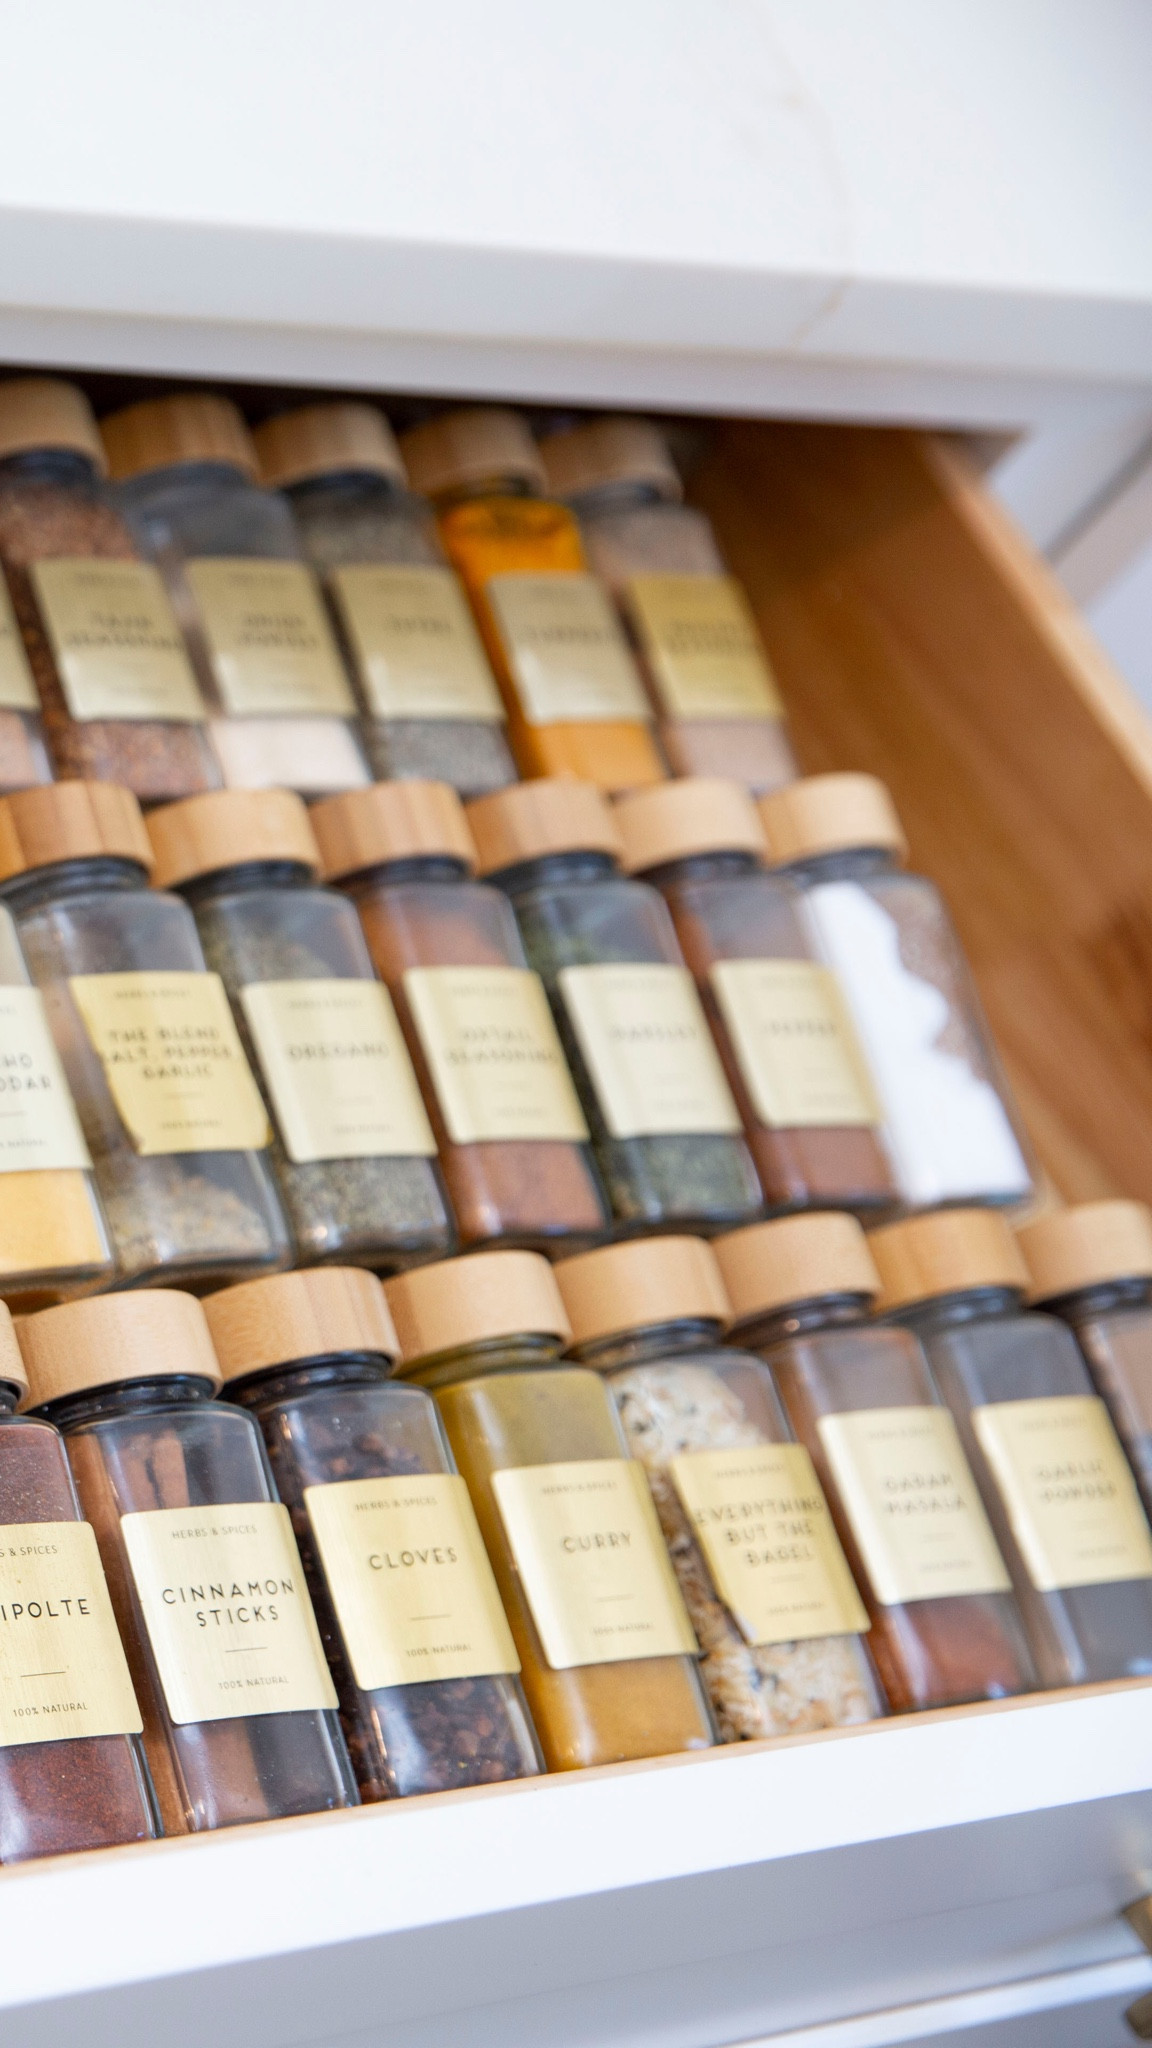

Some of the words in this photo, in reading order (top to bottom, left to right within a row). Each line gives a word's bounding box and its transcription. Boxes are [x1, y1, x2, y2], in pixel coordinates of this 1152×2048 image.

[109, 1027, 148, 1042] THE
[142, 1063, 213, 1080] GARLIC
[355, 1501, 390, 1511] HERBS
[404, 1496, 439, 1507] SPICES
[172, 1527, 208, 1539] HERBS
[211, 1527, 219, 1537] &
[222, 1524, 258, 1536] SPICES
[725, 1522, 768, 1546] BUT
[776, 1519, 815, 1538] THE
[8, 1547, 16, 1557] &
[20, 1544, 59, 1556] SPICES
[560, 1531, 632, 1554] CURRY
[366, 1547, 458, 1571] CLOVES
[745, 1544, 812, 1567] BAGEL
[161, 1579, 295, 1605] CINNAMON
[1, 1598, 91, 1621] IPOLTE
[195, 1605, 280, 1628] STICKS
[405, 1647, 429, 1657] 100%
[432, 1643, 472, 1655] NATURAL
[217, 1680, 243, 1690] 100%
[246, 1675, 290, 1688] NATURAL
[12, 1708, 39, 1718] 100%
[42, 1701, 88, 1715] NATURAL
